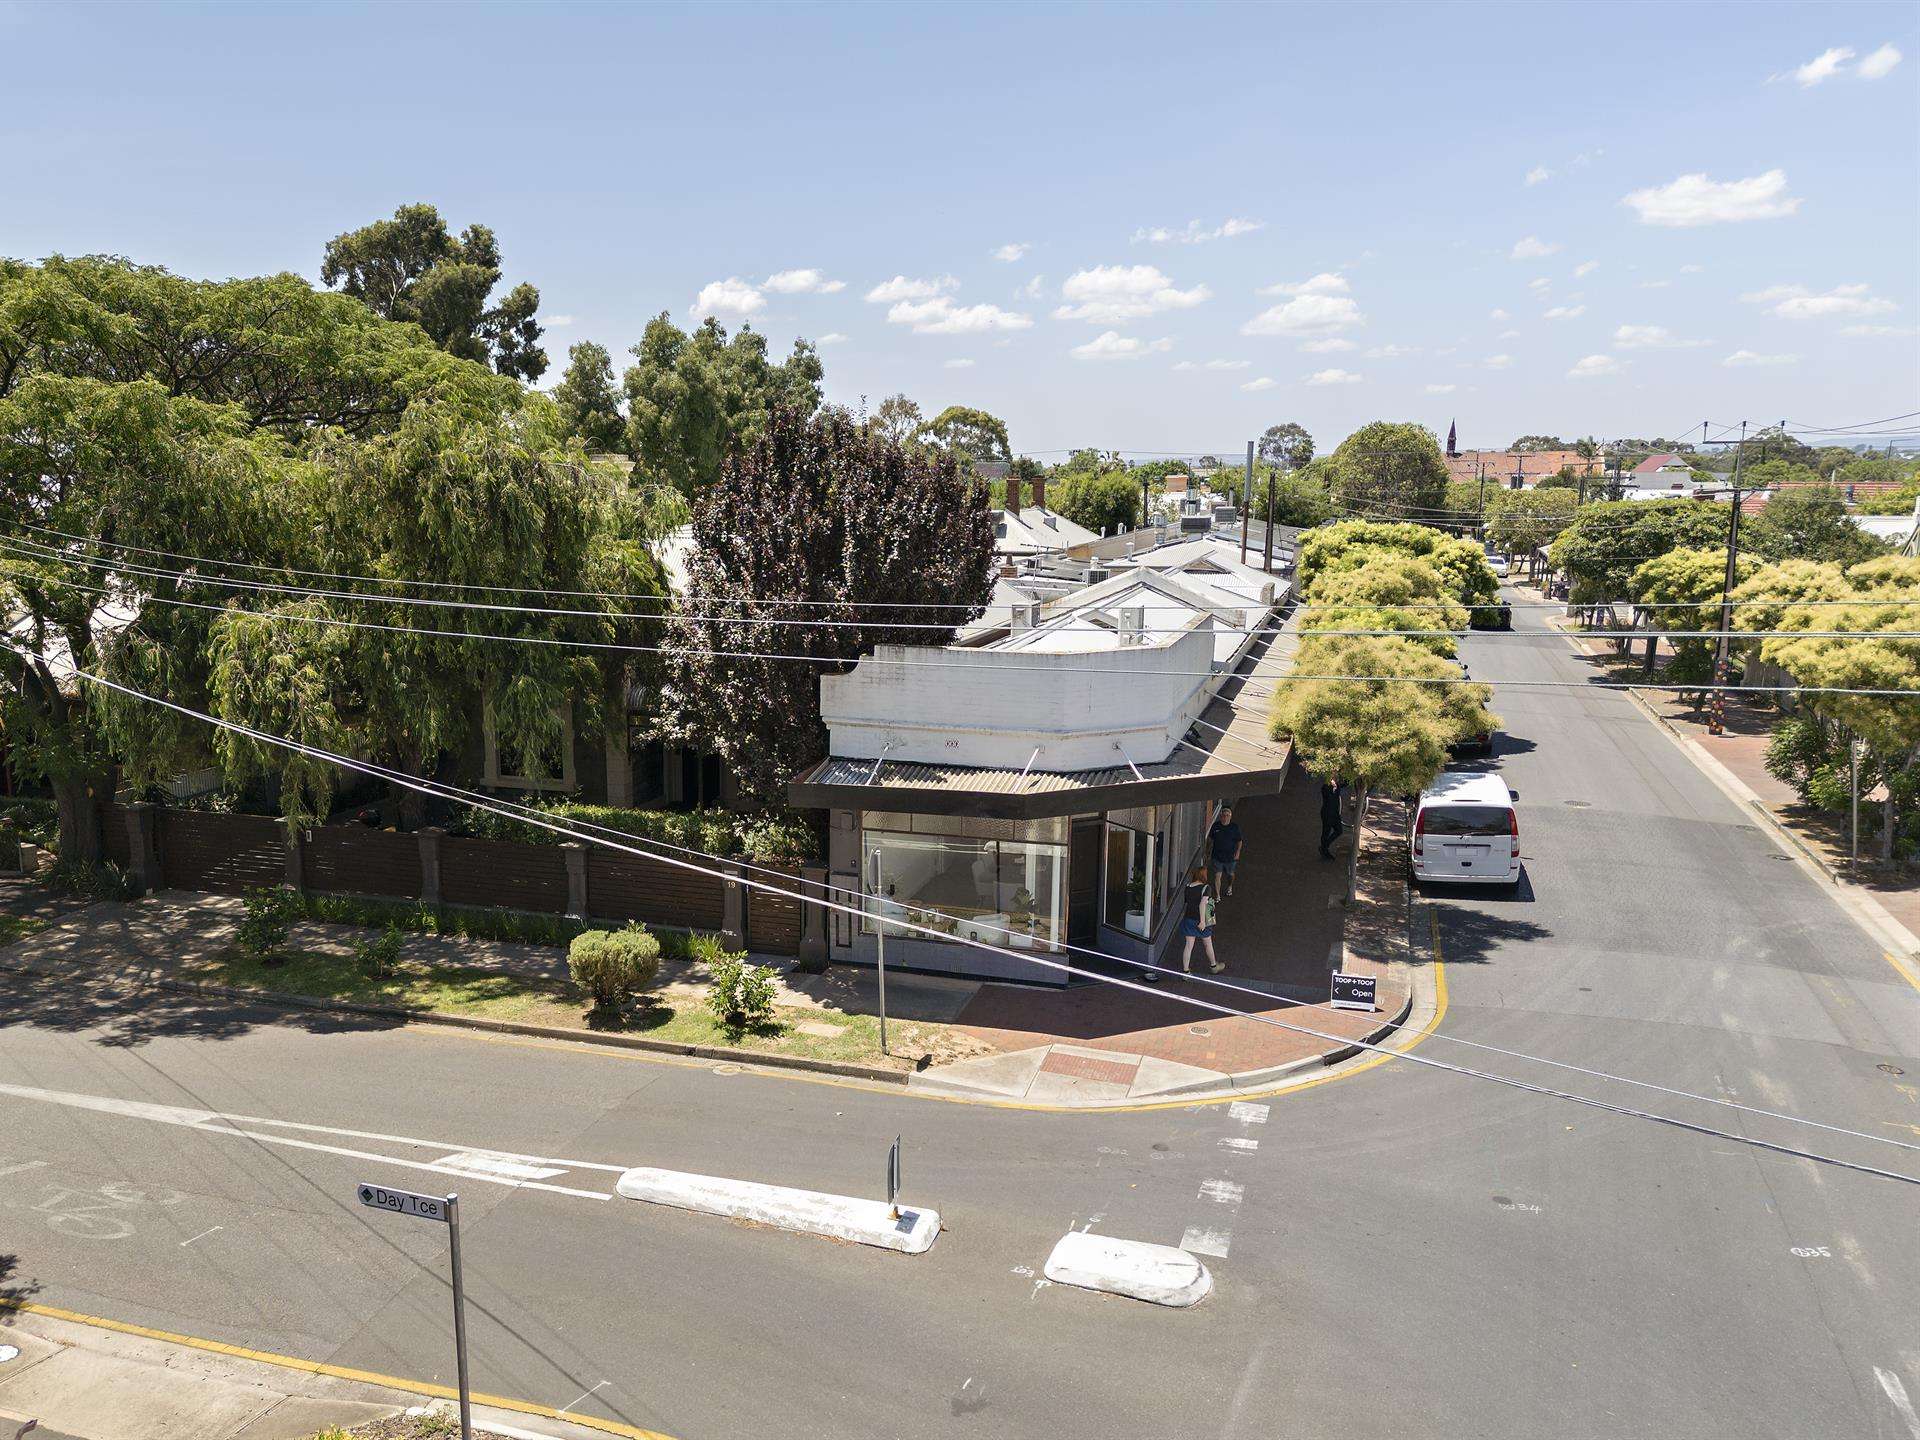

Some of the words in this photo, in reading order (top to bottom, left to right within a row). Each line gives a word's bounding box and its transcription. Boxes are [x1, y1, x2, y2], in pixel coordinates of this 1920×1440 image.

[727, 881, 736, 889] 19
[1351, 988, 1373, 998] Open
[376, 1189, 405, 1212] Day
[409, 1196, 438, 1215] Tce
